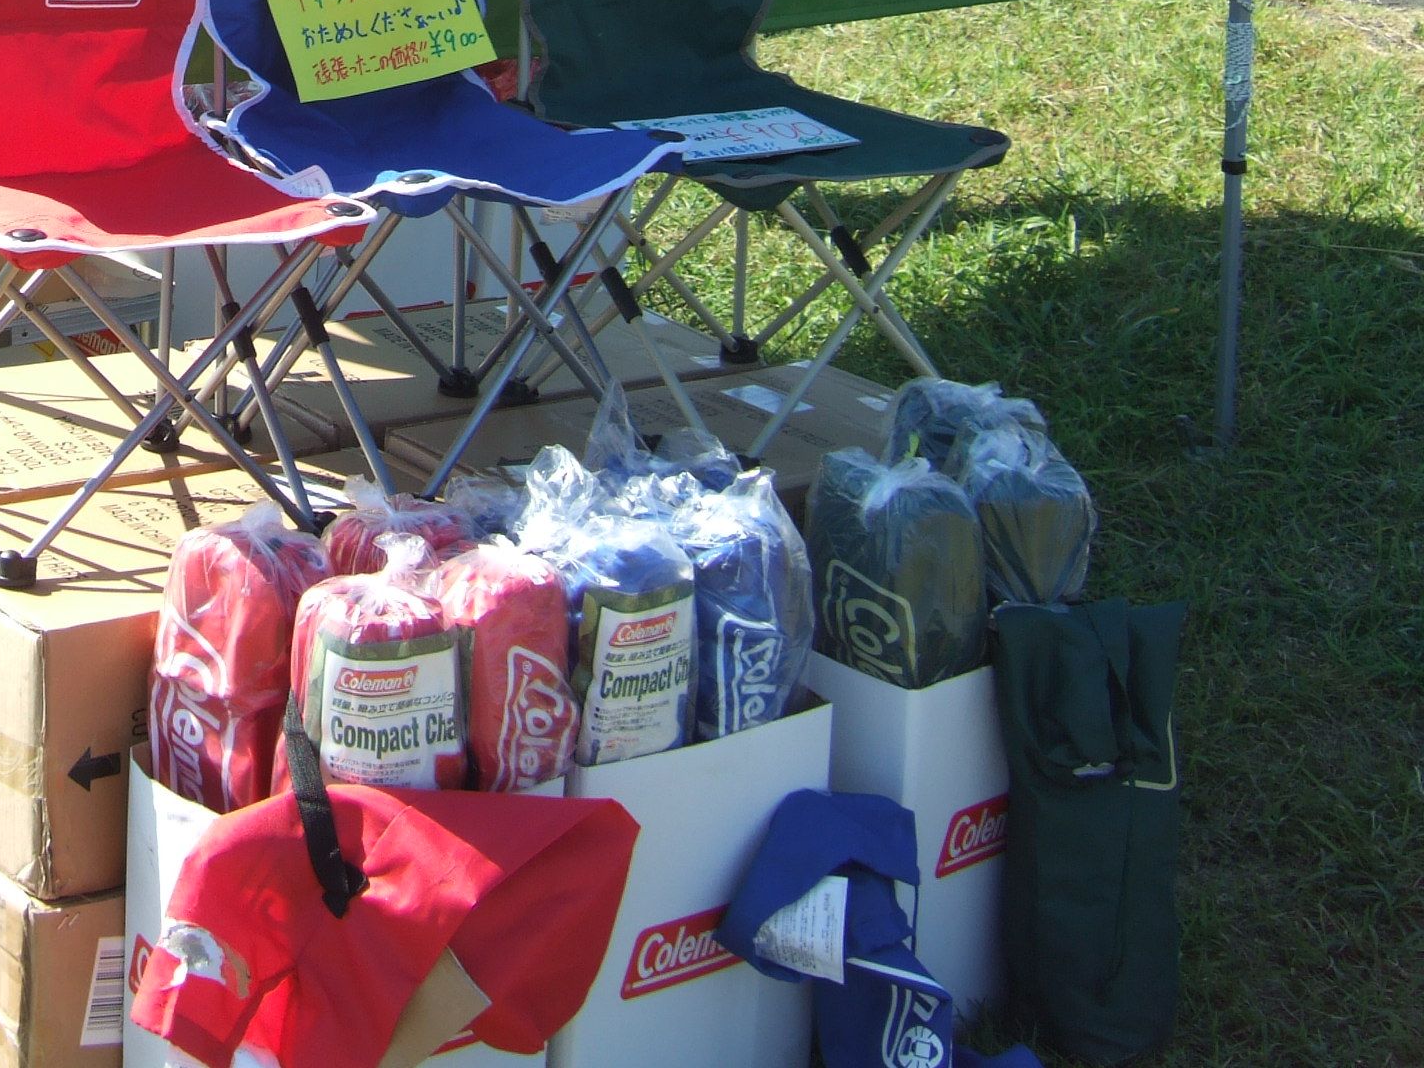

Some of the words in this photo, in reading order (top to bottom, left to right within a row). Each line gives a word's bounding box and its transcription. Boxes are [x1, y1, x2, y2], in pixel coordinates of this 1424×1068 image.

[3, 446, 47, 471] TOKYO
[24, 439, 73, 467] CARTON
[52, 439, 85, 456] PCS
[617, 616, 670, 641] Coleman
[341, 670, 406, 692] Coleman
[600, 660, 673, 701] Compact
[331, 716, 420, 759] Compact
